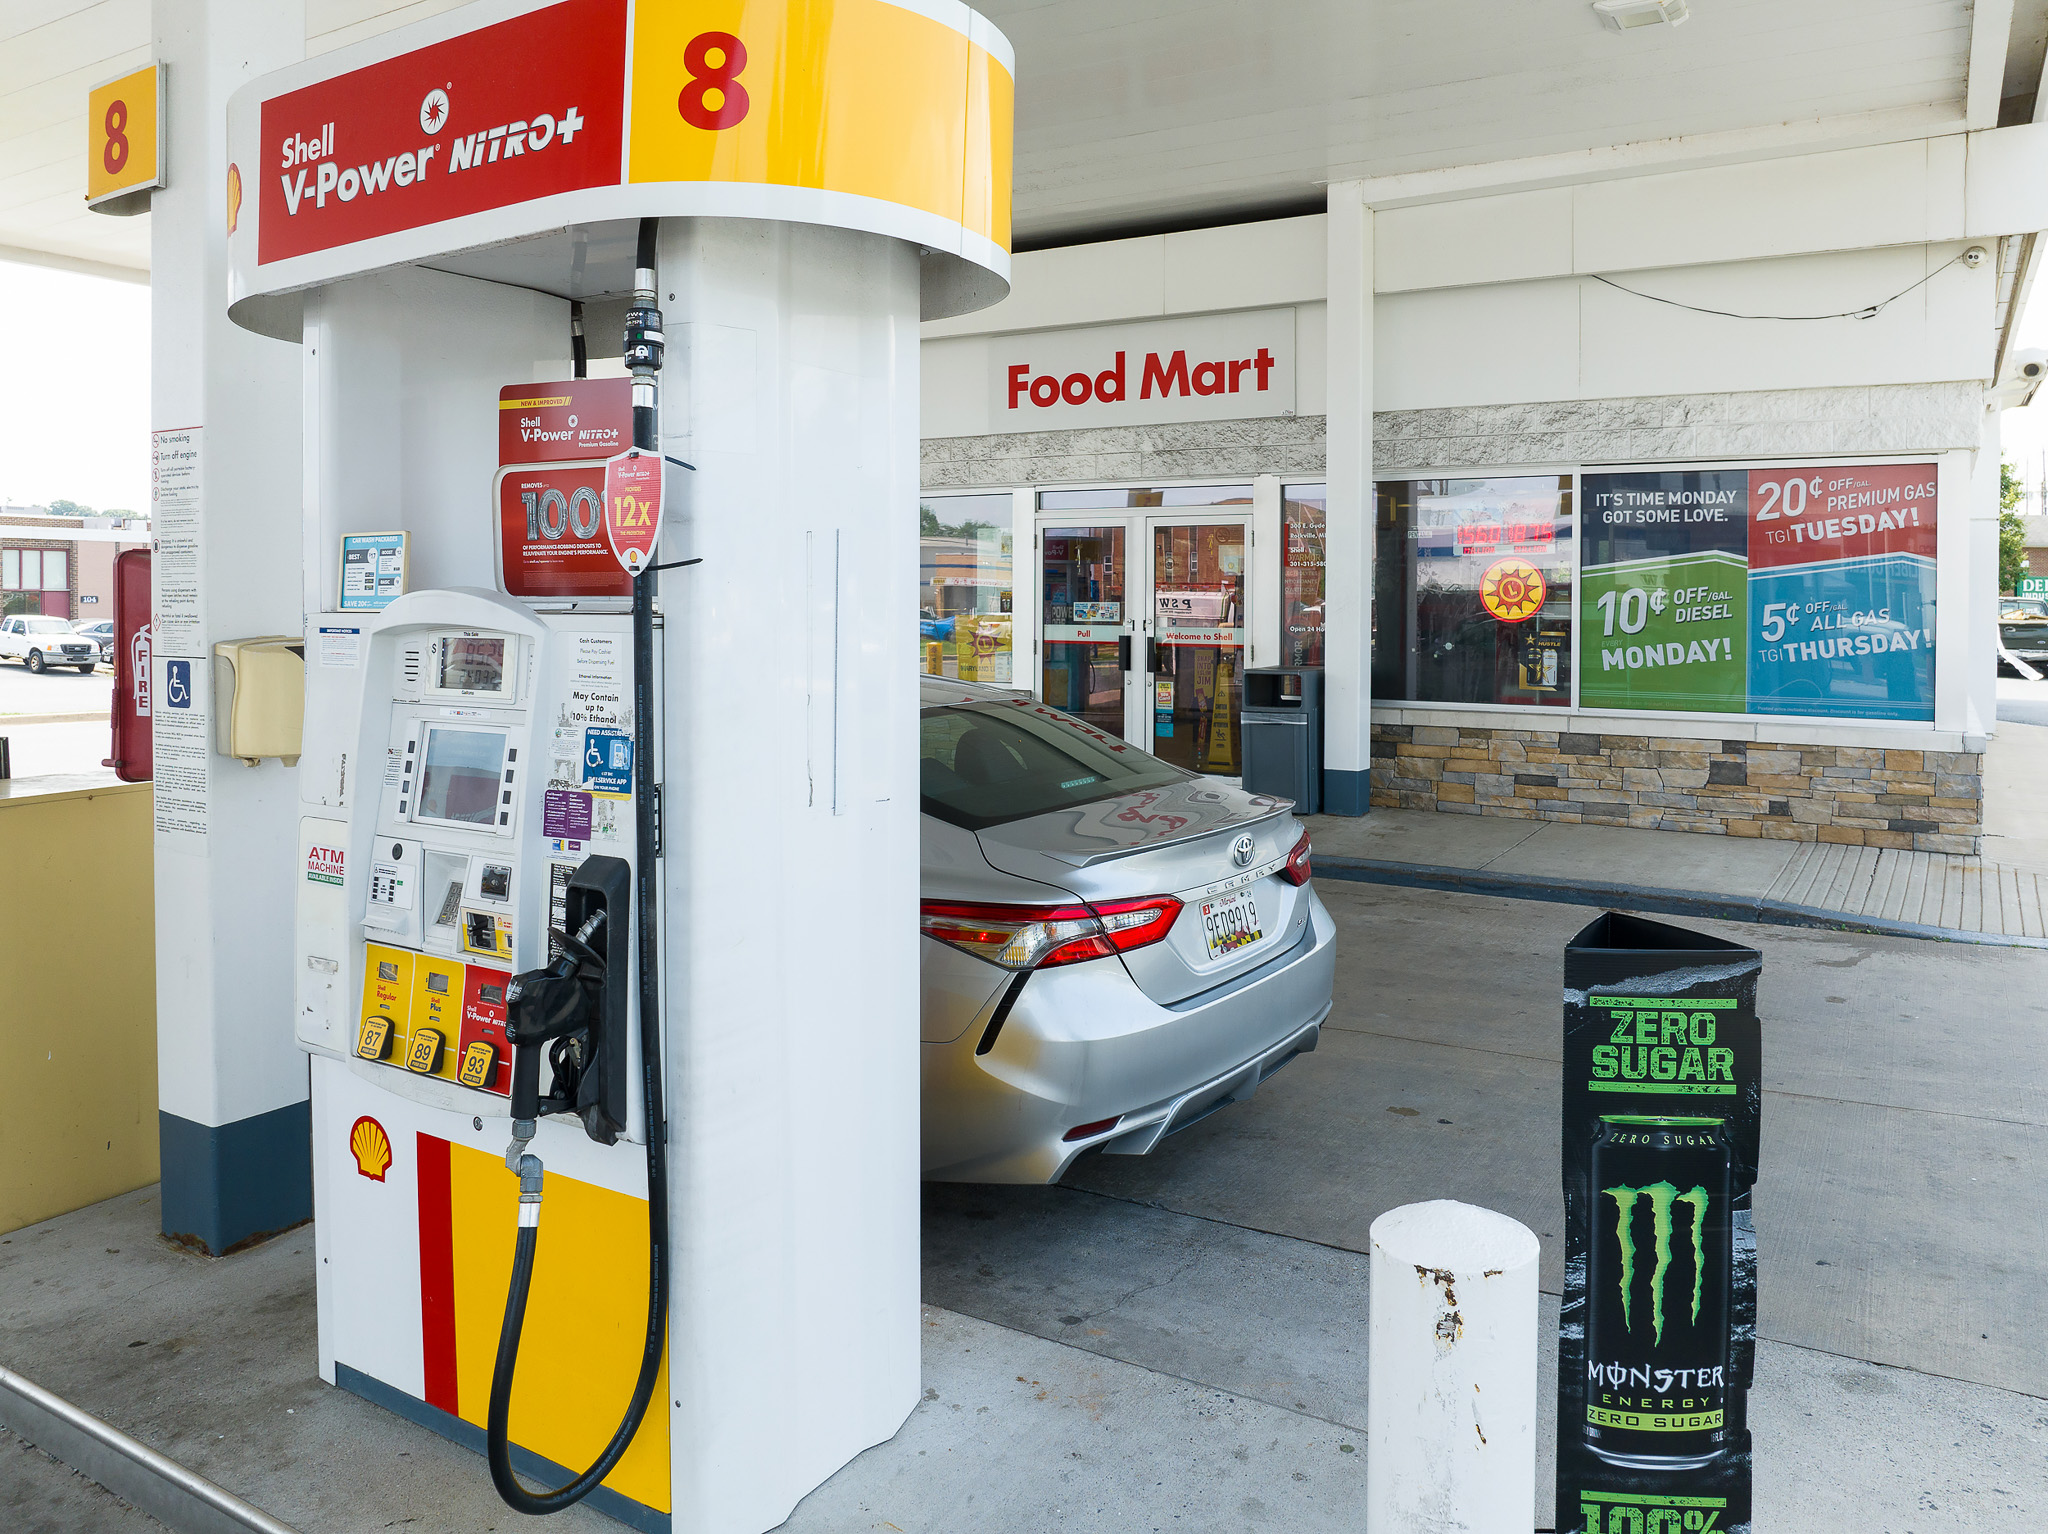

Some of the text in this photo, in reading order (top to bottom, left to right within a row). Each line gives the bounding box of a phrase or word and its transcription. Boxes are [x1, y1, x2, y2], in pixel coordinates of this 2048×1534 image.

[677, 31, 750, 131] 8
[103, 99, 129, 175] 8
[281, 122, 334, 169] Shell
[280, 145, 434, 216] V-Power
[1008, 347, 1275, 410] Food Mart
[537, 398, 563, 406] IMPROVED
[520, 416, 541, 428] Shell
[160, 433, 190, 444] No smoking
[520, 428, 575, 443] V-Power
[160, 449, 198, 461] Turn off engine
[1595, 490, 1737, 507] IT'S TIME MONDAY
[1755, 475, 1823, 523] 20¢
[1827, 481, 1936, 513] PREMIUM GAS
[1602, 508, 1730, 525] GOT SOME LOVE.
[1309, 522, 1326, 530] Gude
[1764, 505, 1921, 545] TGI TUESDAY!
[352, 535, 399, 544] CAR WASH PACKAGES
[1289, 532, 1318, 540] Rockville,
[1463, 545, 1548, 554] MILLION MILLION
[1596, 587, 1667, 637] 10¢
[1675, 603, 1733, 623] DIESEL
[1760, 602, 1801, 643] 5¢
[1810, 608, 1890, 633] ALL GAS
[1077, 630, 1091, 638] Pull
[1165, 632, 1233, 641] Welcome to Shell
[1601, 639, 1623, 647] EVERY
[1758, 627, 1933, 664] TGI THURSDAY!
[1601, 637, 1733, 672] MONDAY!
[960, 664, 989, 672] MARYLAND
[1196, 662, 1211, 670] INTO
[137, 649, 149, 709] FIRE
[1196, 676, 1211, 685] JIM
[572, 691, 619, 702] May Contain
[585, 704, 605, 713] up to
[572, 712, 617, 724] 10% Ethanol
[587, 728, 601, 736] NEED
[617, 778, 627, 786] APP
[308, 846, 345, 865] ATM
[307, 860, 345, 876] MACHINE
[308, 872, 344, 884] AVAILABLE INSIDE
[1206, 863, 1276, 895] CAMRY
[377, 984, 386, 992] Shell
[376, 990, 397, 1002] Regular
[429, 1002, 442, 1013] Plus
[466, 1005, 477, 1013] Shell
[466, 1010, 492, 1024] V-Power
[1610, 1010, 1717, 1046] ZERO
[364, 1029, 382, 1047] 87
[414, 1043, 431, 1062] 89
[467, 1055, 485, 1075] 93
[1591, 1044, 1735, 1082] SUGAR
[1609, 1132, 1716, 1146] ZERO SUGAR
[1602, 1393, 1710, 1409] ENERGY
[1588, 1408, 1723, 1428] ZERO SUGAR
